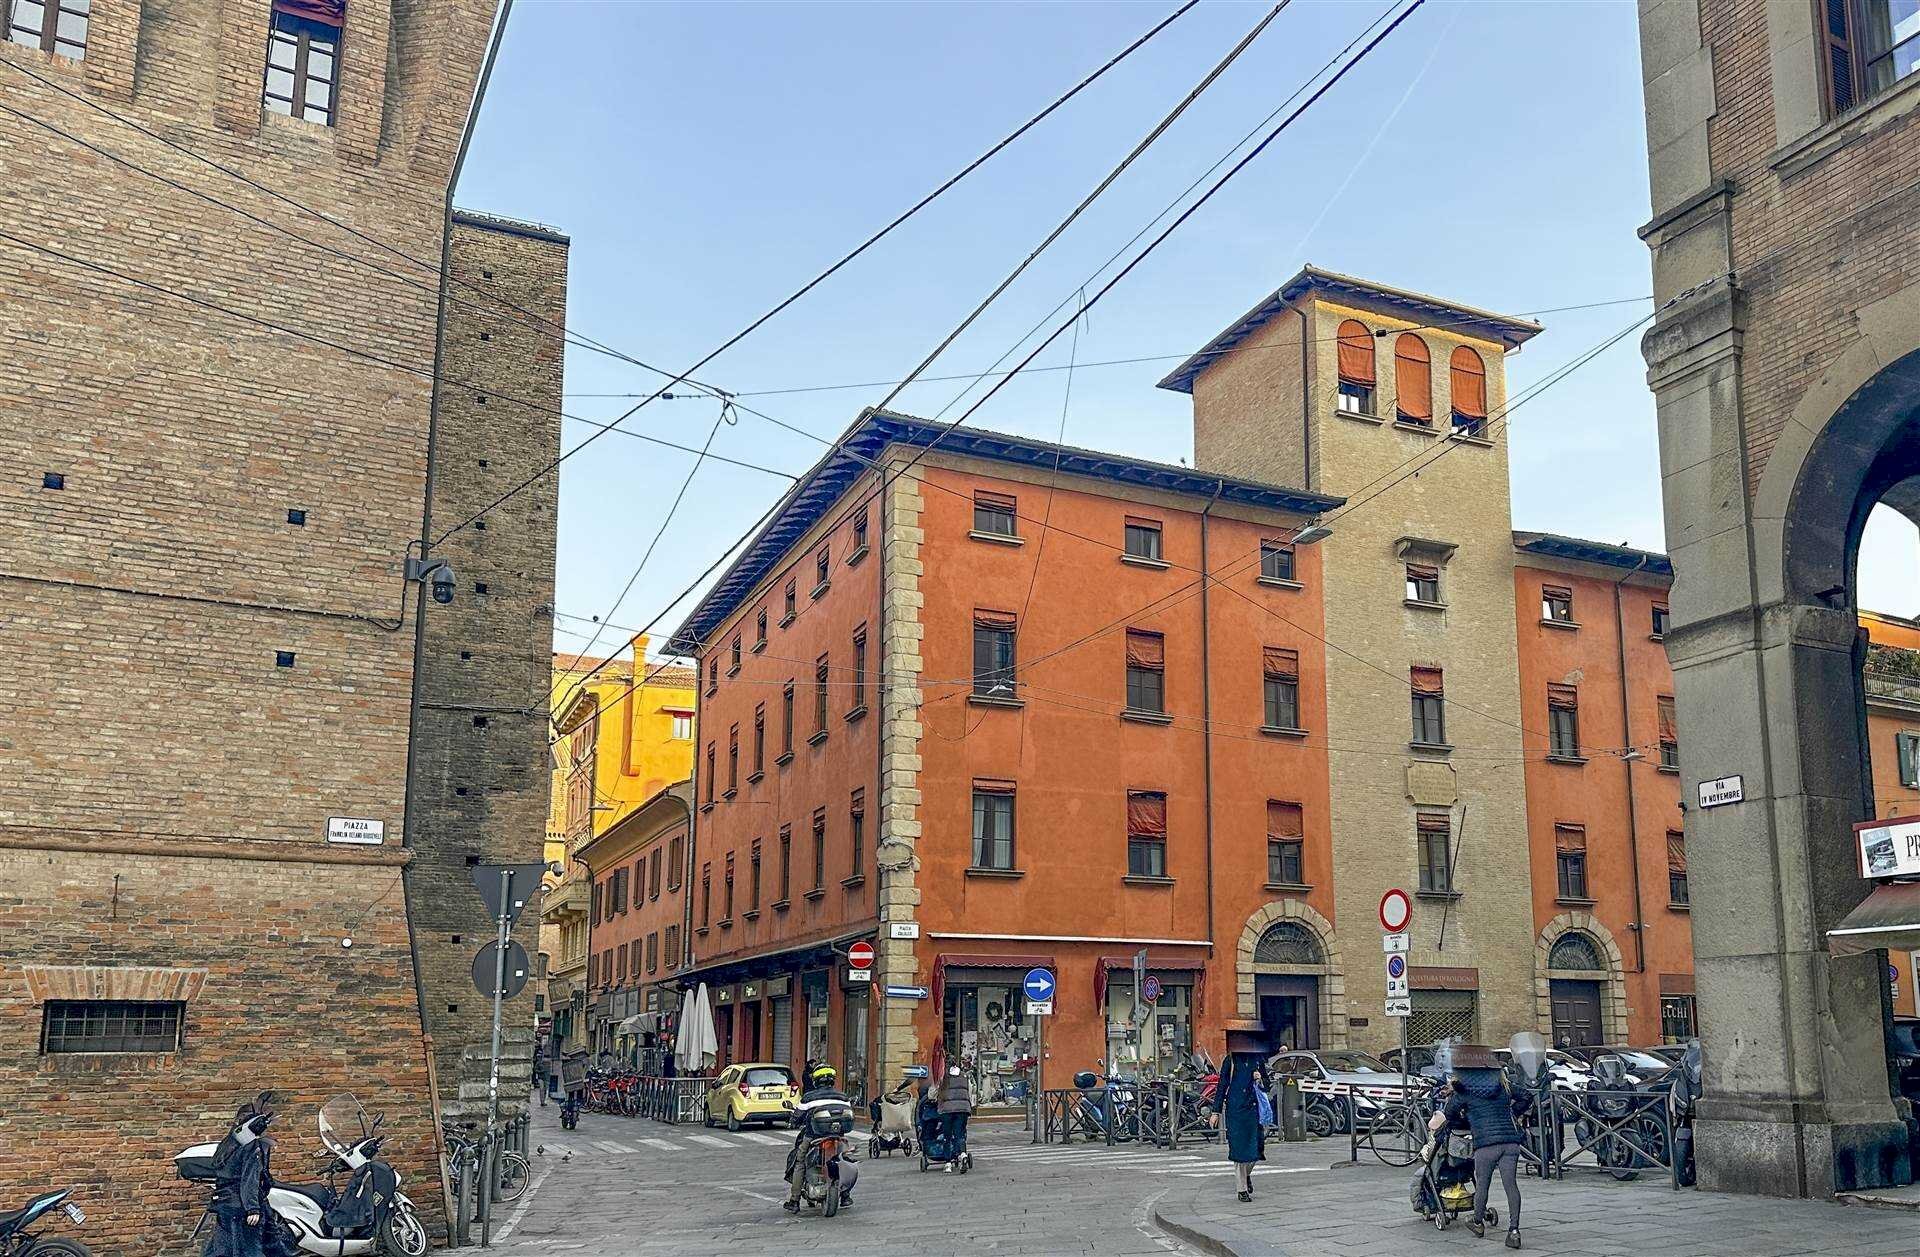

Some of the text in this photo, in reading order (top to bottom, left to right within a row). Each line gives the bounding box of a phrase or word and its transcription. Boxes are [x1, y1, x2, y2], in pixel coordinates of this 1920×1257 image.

[1716, 782, 1725, 790] VIA
[1701, 790, 1740, 804] IV NOVEMBRE
[344, 821, 368, 830] PIAZZA
